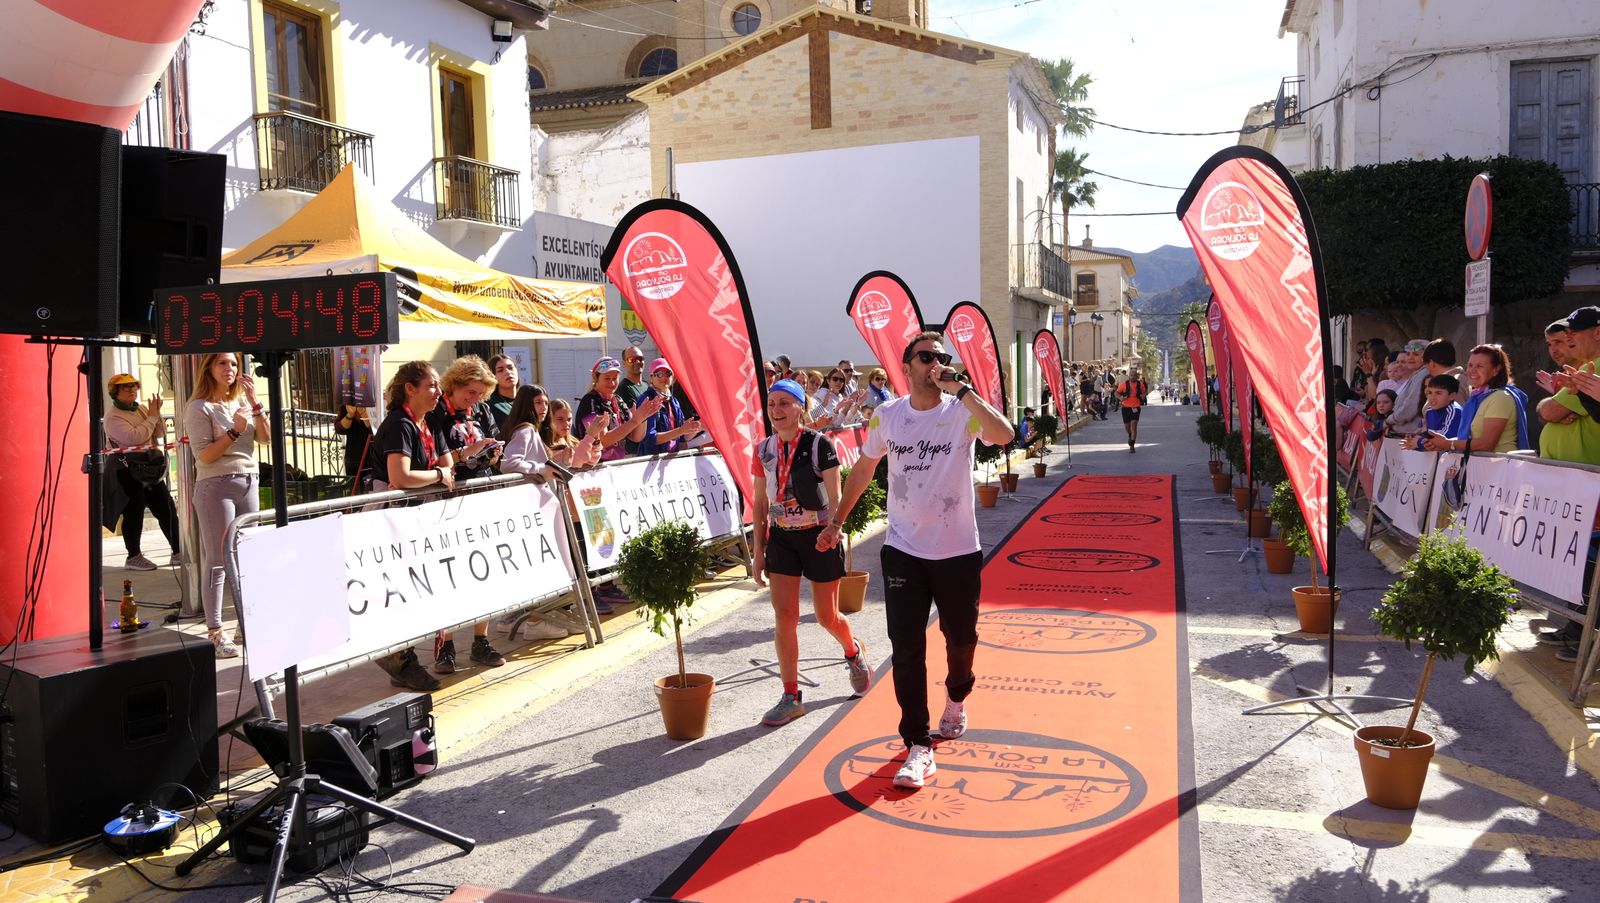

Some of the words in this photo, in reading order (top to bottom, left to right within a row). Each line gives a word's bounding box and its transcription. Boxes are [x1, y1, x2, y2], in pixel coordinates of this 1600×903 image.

[163, 280, 381, 348] 03:04:48
[916, 439, 953, 461] Yepes
[616, 477, 707, 503] AYUNTAMIENTO
[711, 474, 724, 487] DE
[619, 489, 733, 535] CANTORIA
[1562, 501, 1583, 522] DE
[345, 518, 517, 570] YUNTAMIENTO
[522, 511, 544, 530] DE
[1459, 502, 1579, 567] ANTORIA
[346, 533, 557, 616] CANTORIA
[984, 614, 1093, 625] POLVORA
[1101, 619, 1131, 627] LA
[934, 680, 1117, 700] Ayuntamieo
[974, 674, 1070, 686] Cantor
[1079, 680, 1103, 688] de
[884, 741, 1049, 765] POLVOA
[1062, 756, 1106, 770] LA
[276, 807, 294, 846] VONYX
